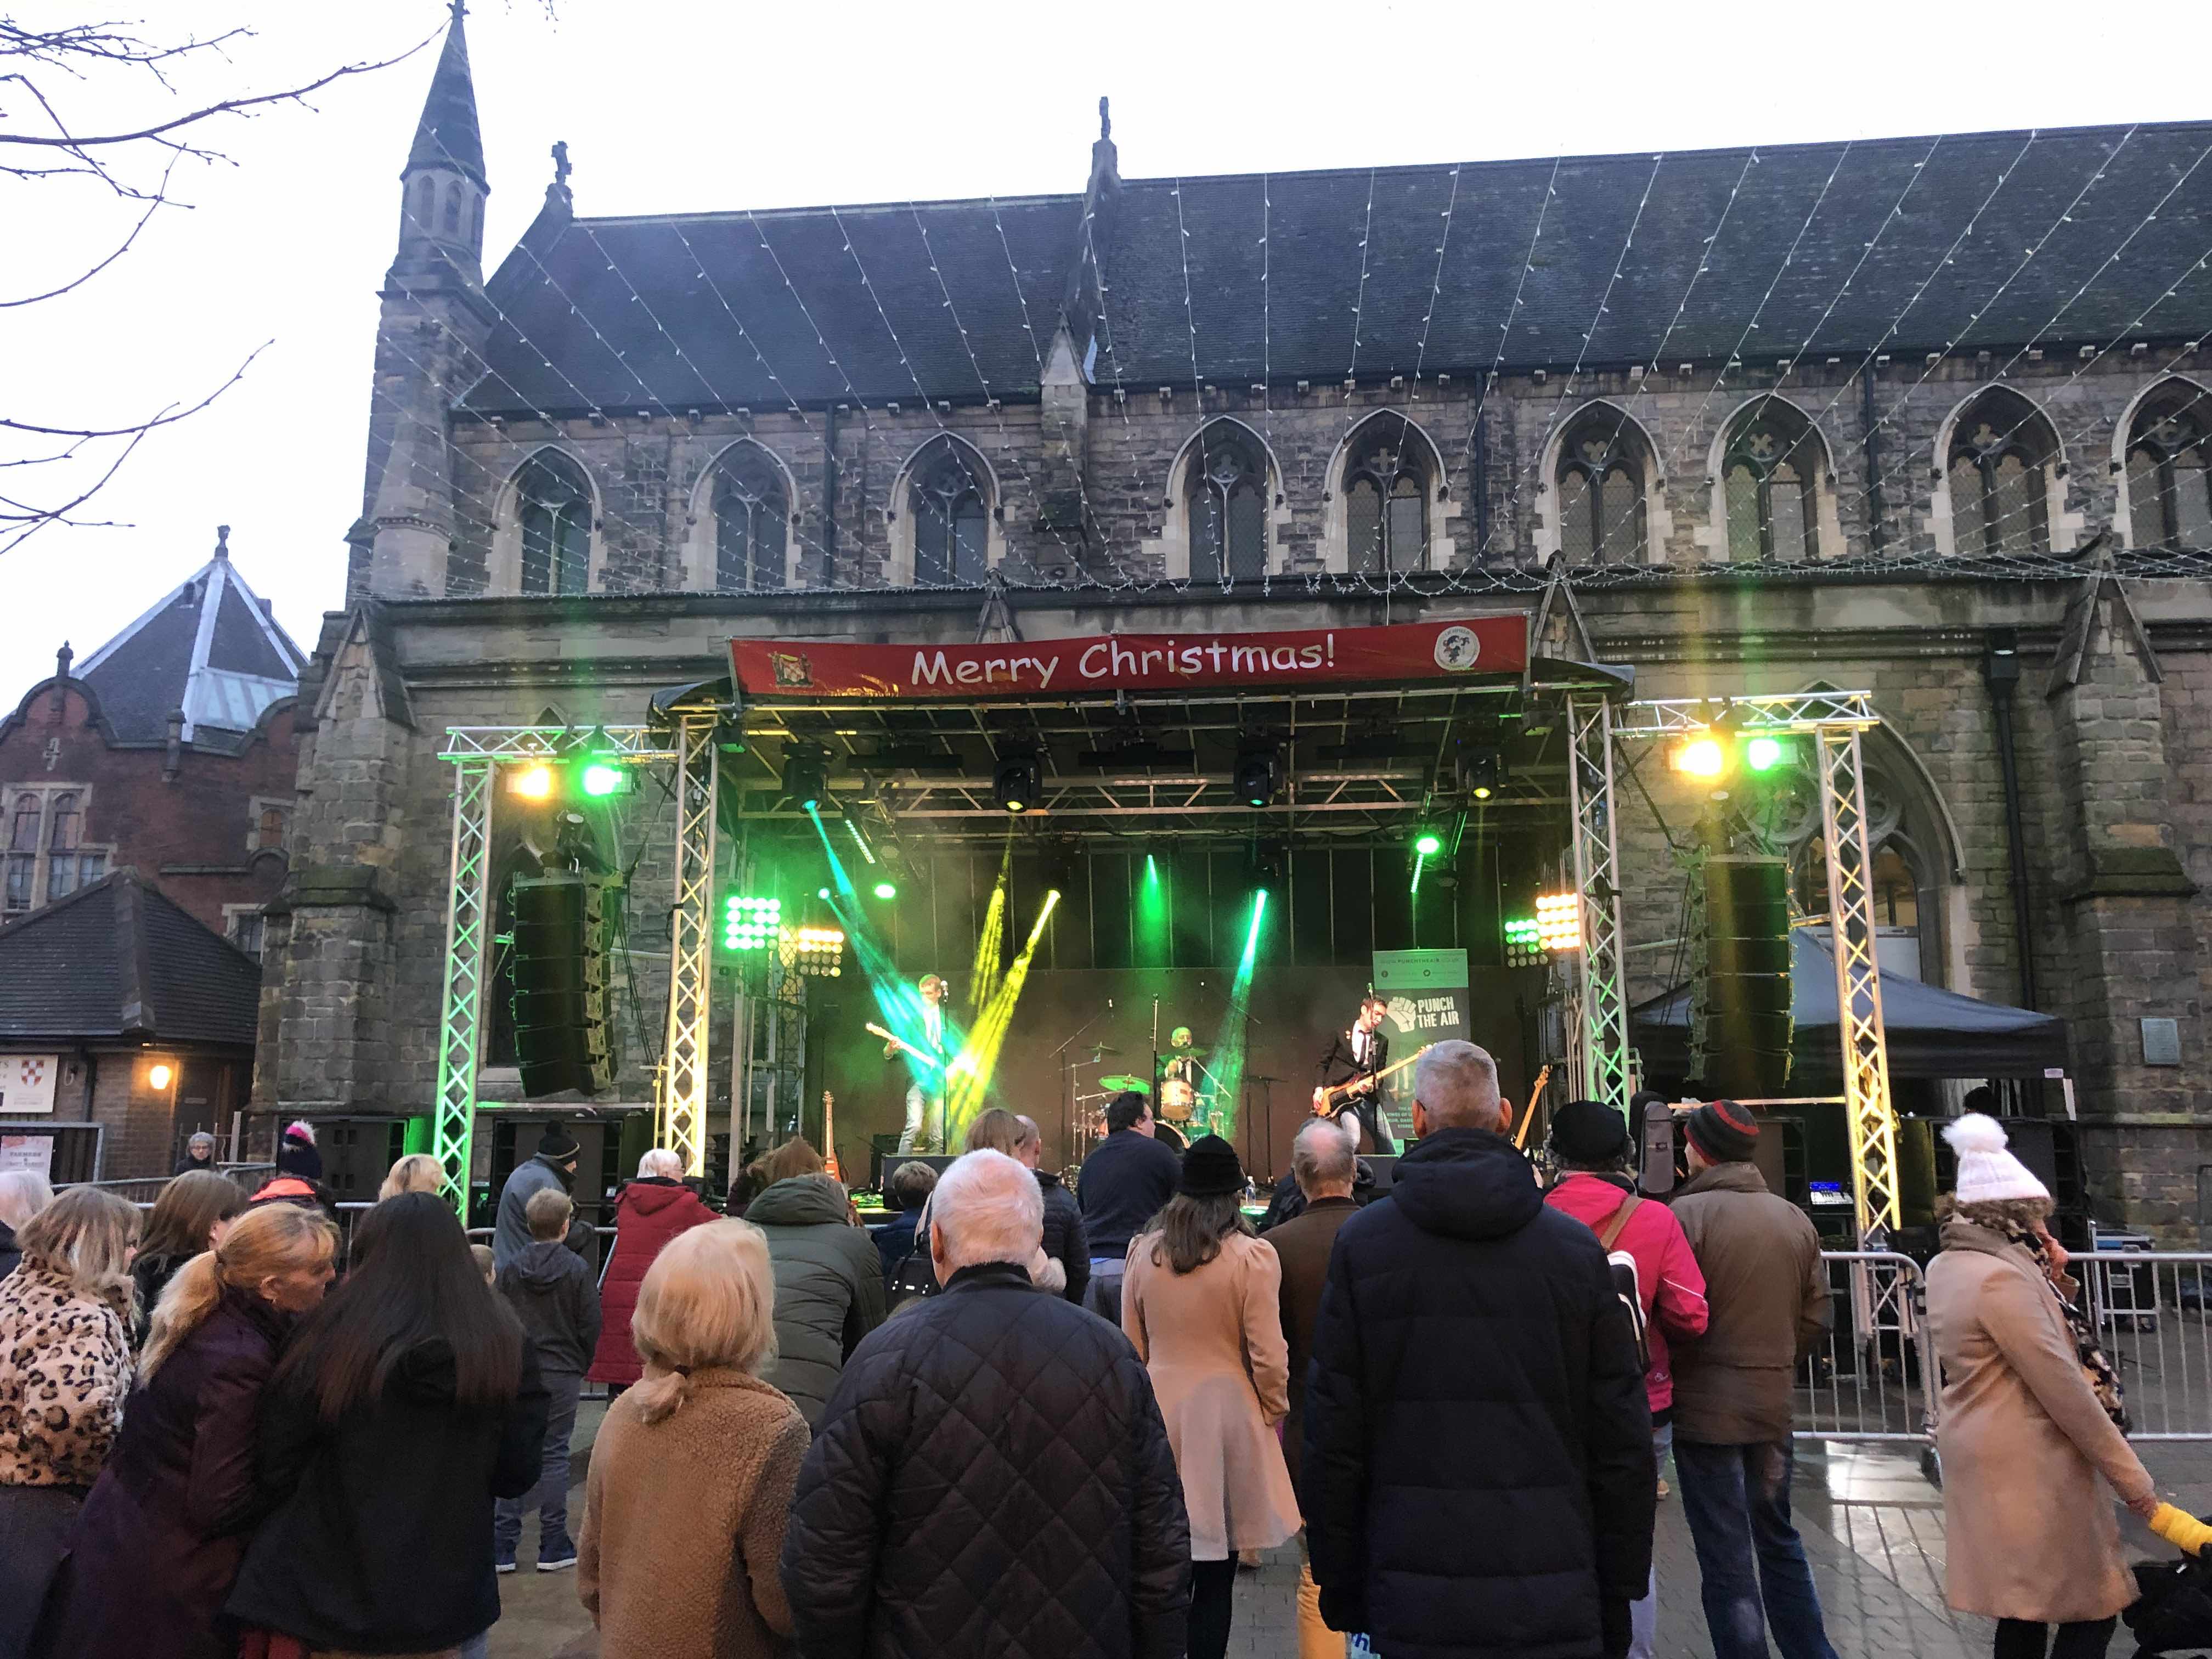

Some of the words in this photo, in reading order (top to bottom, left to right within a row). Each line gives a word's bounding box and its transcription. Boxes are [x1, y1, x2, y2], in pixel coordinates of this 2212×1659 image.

[911, 651, 1059, 689] Merry
[1079, 633, 1334, 678] Christmas!
[1417, 996, 1454, 1013] PUNCH
[1417, 1013, 1437, 1028] THE
[1440, 1011, 1459, 1026] AIR
